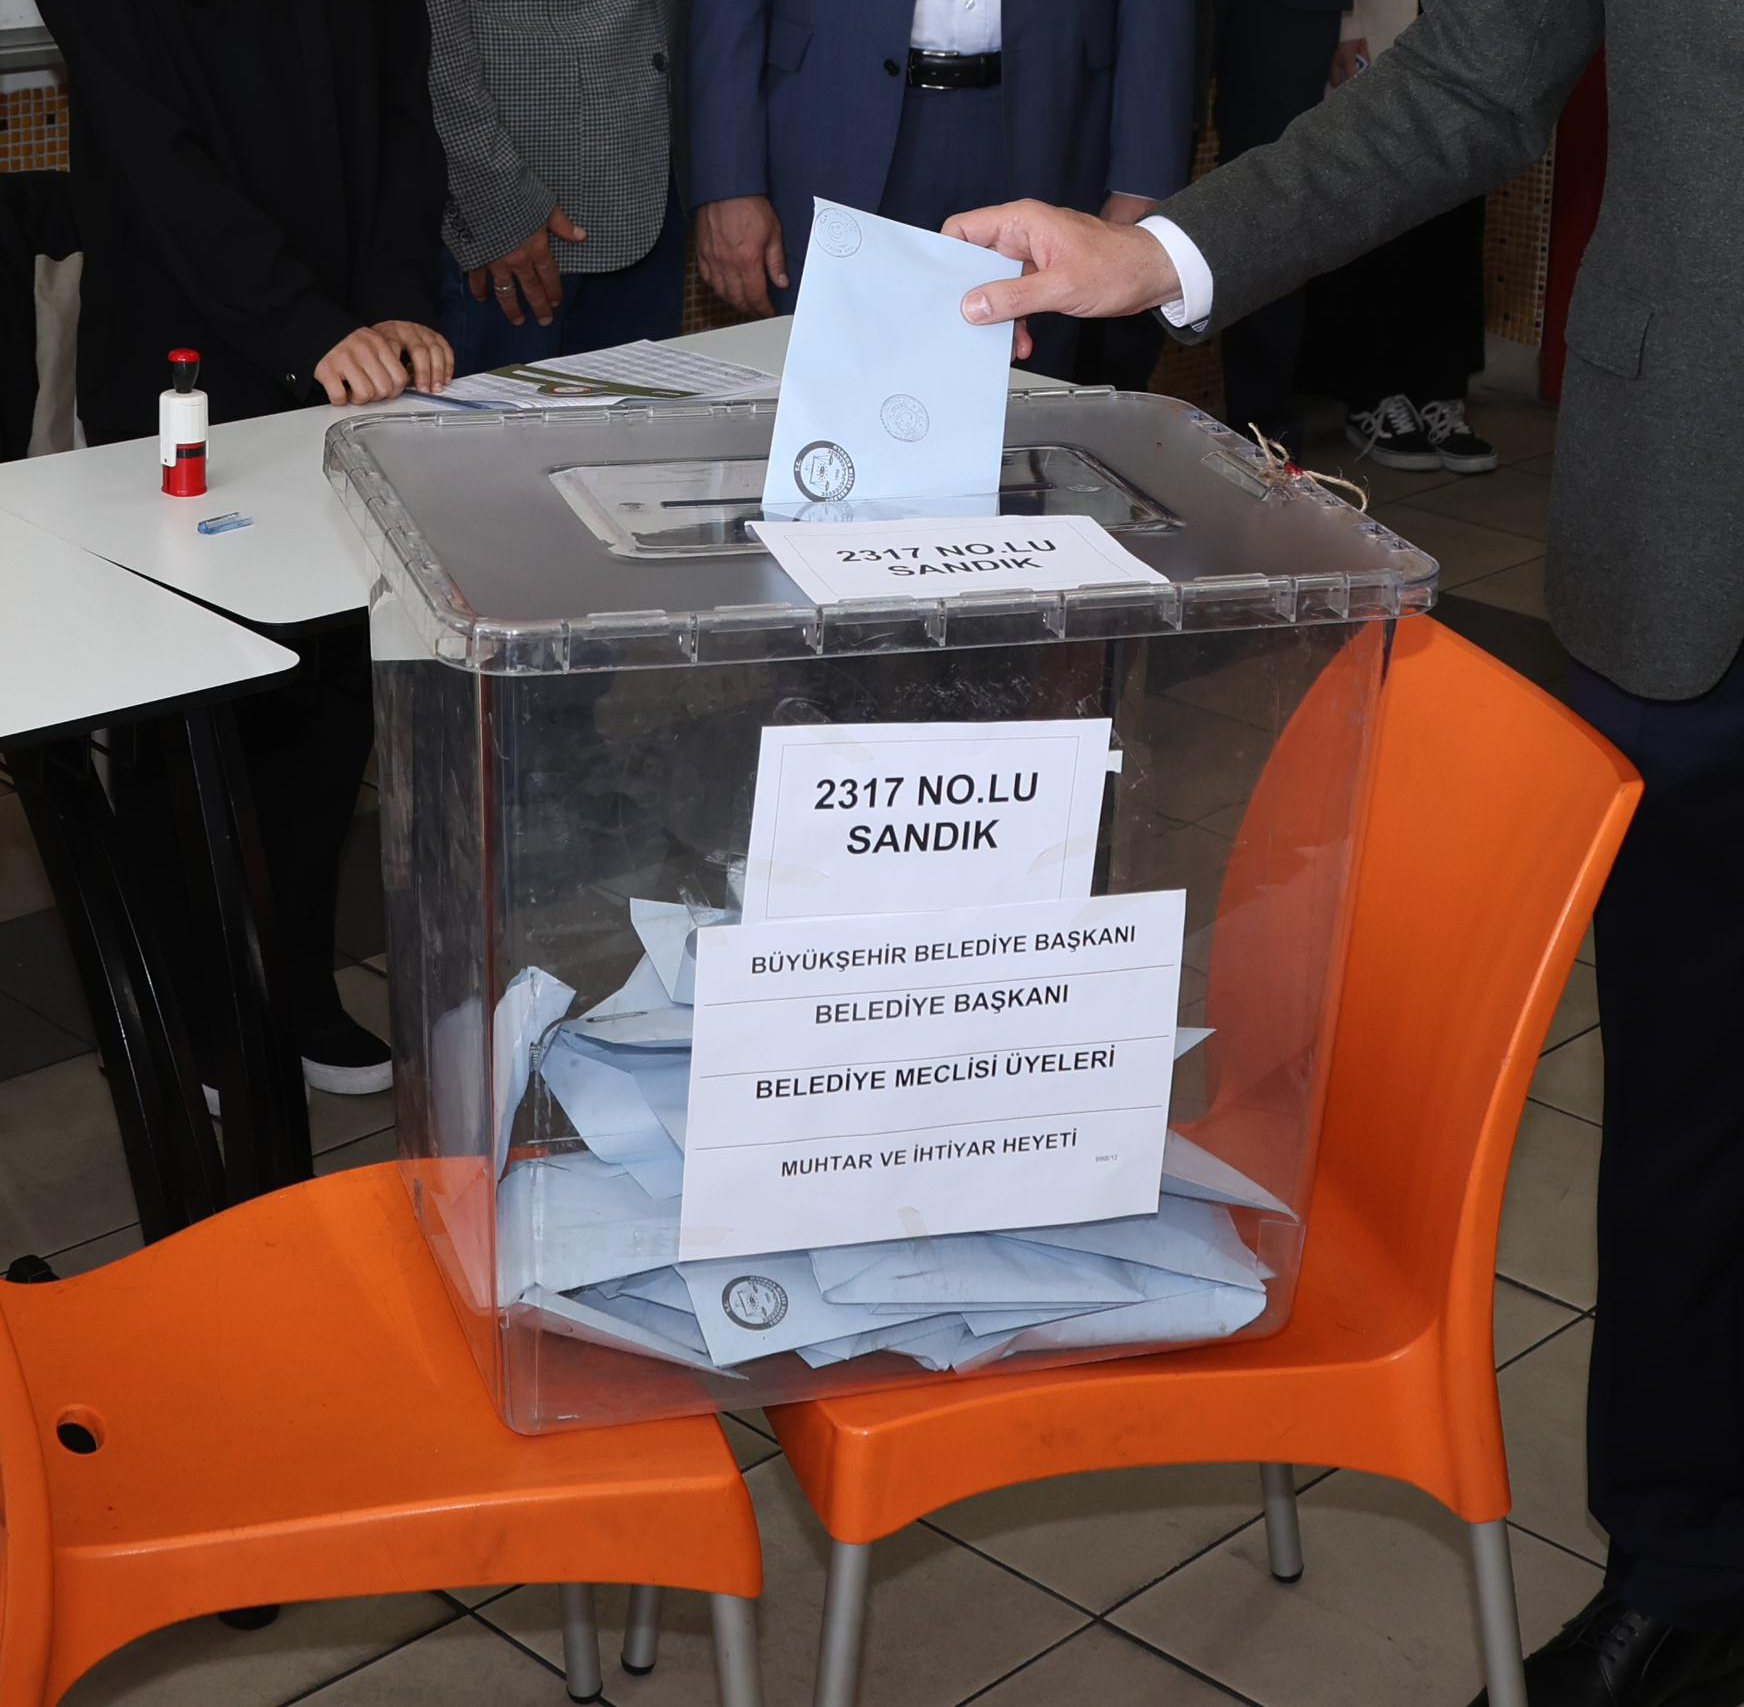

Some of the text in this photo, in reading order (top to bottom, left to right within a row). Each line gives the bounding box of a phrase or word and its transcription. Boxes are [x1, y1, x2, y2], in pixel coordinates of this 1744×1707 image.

[837, 539, 1057, 563] 2317 NO.LU
[888, 557, 1042, 577] SANDIK
[814, 772, 1038, 810] 2317 NO.LU
[846, 819, 1000, 855] SANDIK
[751, 925, 1136, 974] BÜYÜKŞEHİR BELEDİYE BAŞKANI
[815, 984, 1069, 1025] BELEDİYE BAŞKANI
[756, 1044, 1115, 1100] BELEDİYE MECLİSİ ÜYELERİ
[781, 1127, 1077, 1177] MUHTAR VE İHTİYAR HEYETİ
